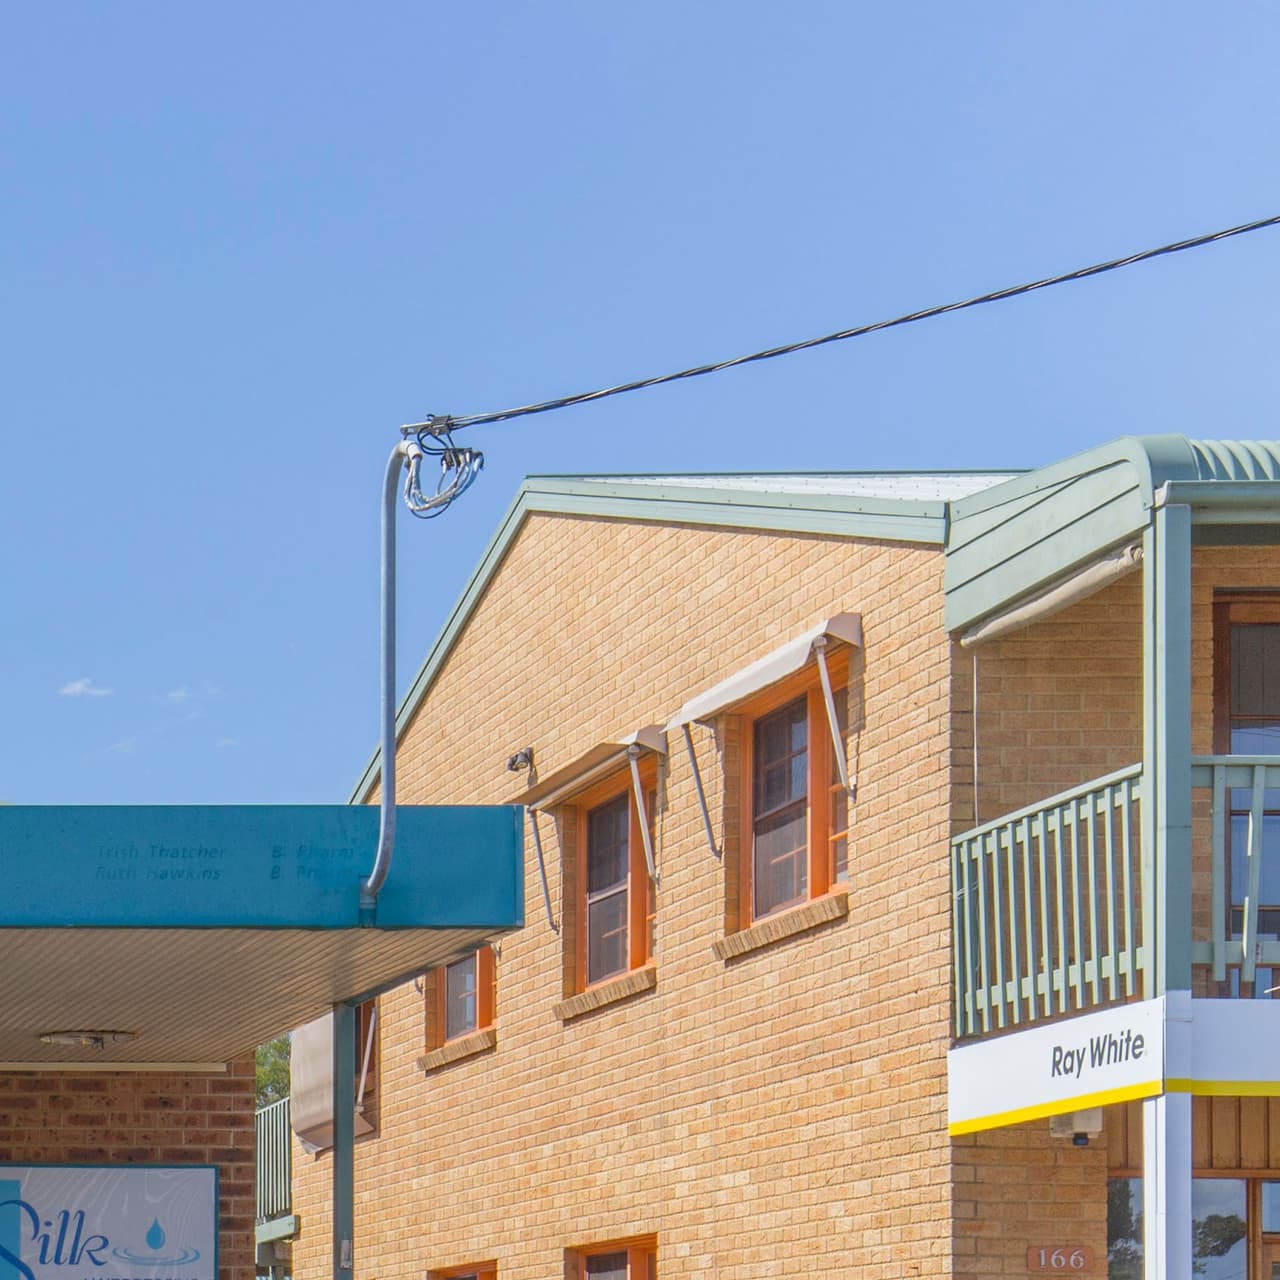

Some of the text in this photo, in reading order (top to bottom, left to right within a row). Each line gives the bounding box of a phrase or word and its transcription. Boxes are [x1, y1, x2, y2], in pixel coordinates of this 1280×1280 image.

[1051, 1028, 1146, 1079] Ray White
[1039, 1247, 1087, 1270] 166
